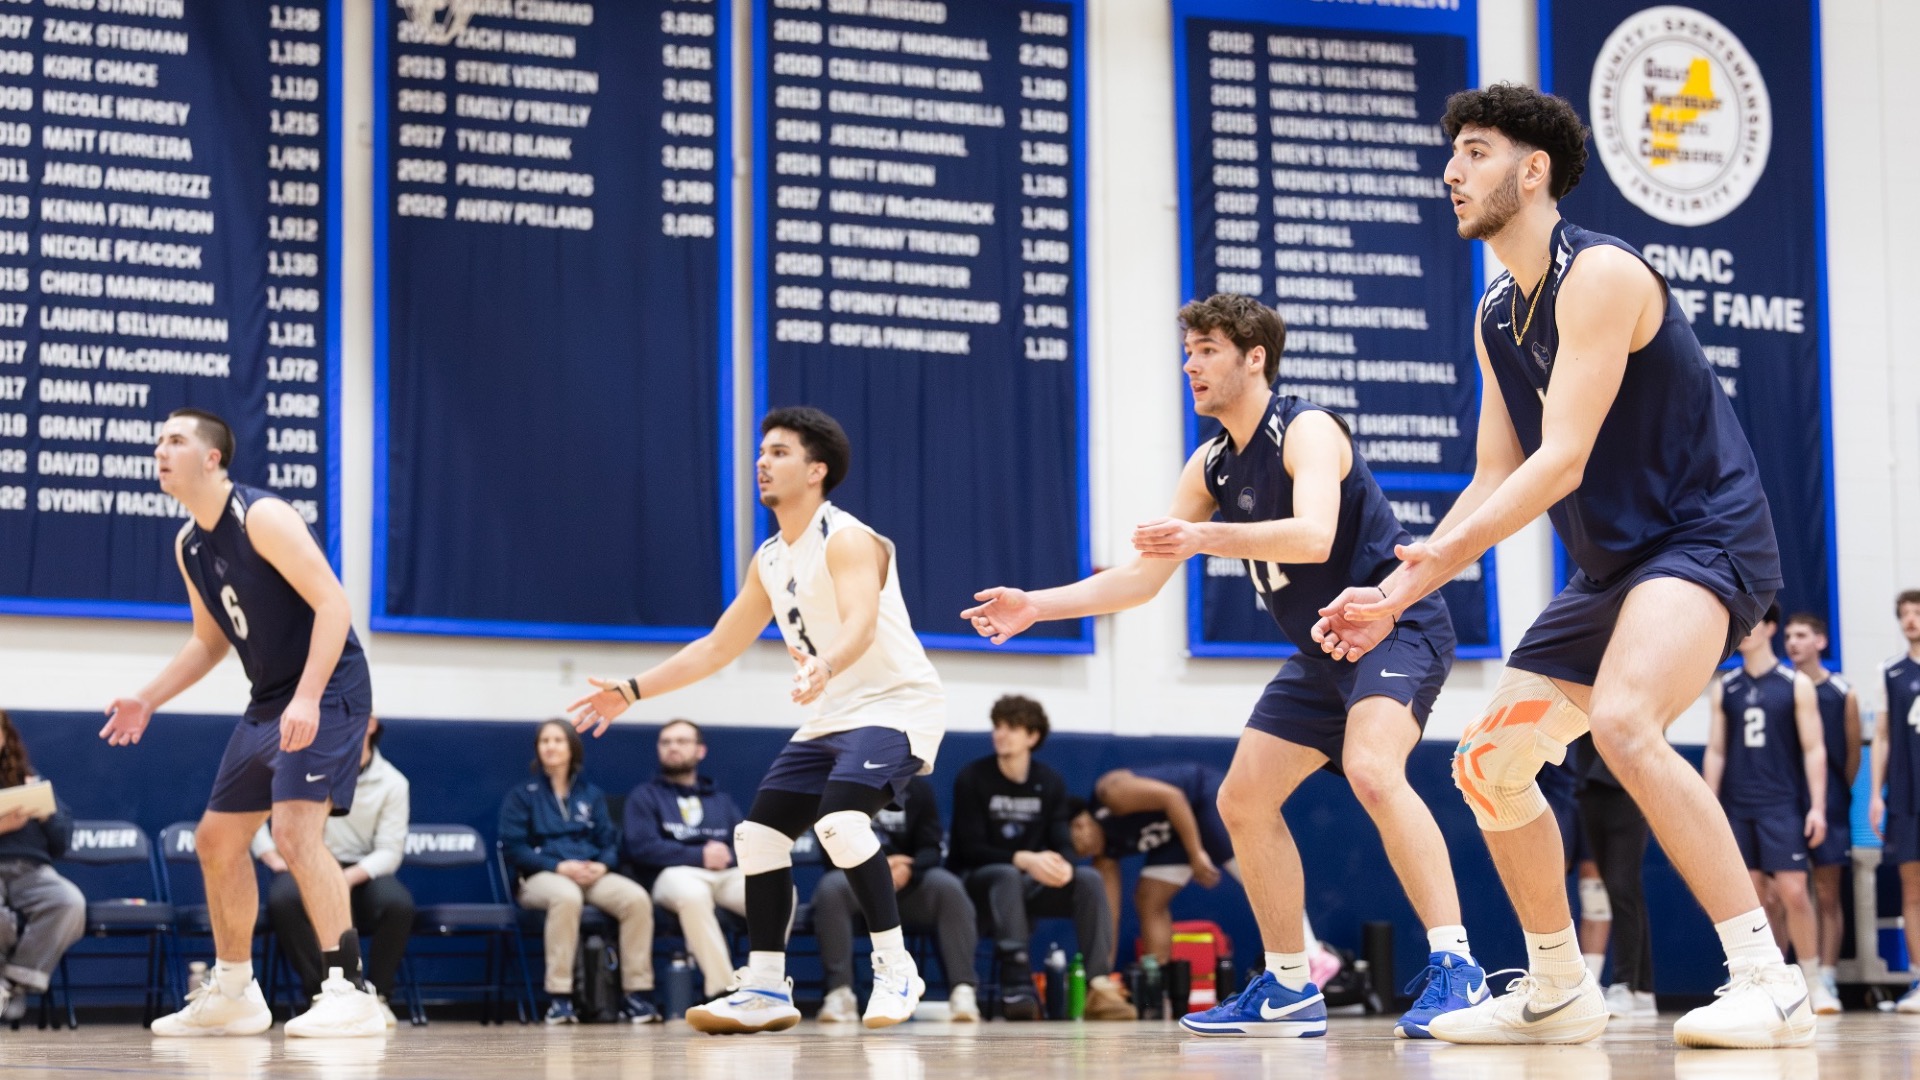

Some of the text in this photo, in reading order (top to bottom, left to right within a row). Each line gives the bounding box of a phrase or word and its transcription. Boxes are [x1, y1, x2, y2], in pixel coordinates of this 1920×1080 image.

[44, 19, 93, 45] ZACK
[96, 24, 188, 55] STEDMAN
[43, 55, 92, 81] KORI
[95, 60, 157, 87] CHACE
[456, 60, 511, 86] STEVE
[43, 90, 113, 118] NICOLE
[116, 97, 190, 125] HERSEY
[457, 95, 513, 120] EMILY
[514, 100, 590, 127] O'REILLY
[43, 126, 97, 152] MATT
[99, 131, 192, 161] FERREIRA
[457, 129, 511, 154] TYLER
[513, 134, 571, 159] BLANK
[42, 162, 102, 188] JARED
[104, 167, 210, 199] ANDREOZZI
[456, 164, 515, 189] PEDRO
[517, 169, 594, 196] CAMPOS
[41, 198, 106, 225] KENNA
[109, 203, 214, 234] FINLAYSON
[455, 199, 513, 223] AVERY
[515, 203, 593, 230] POLLARD
[830, 191, 885, 216] MOLLY
[41, 234, 111, 261] NICOLE
[114, 239, 201, 269] PEACOCK
[1643, 244, 1734, 284] GNAC
[40, 270, 103, 297] CHRIS
[106, 275, 214, 305] MARKUSON
[830, 290, 898, 316] SYDNEY
[40, 307, 114, 333] LAUREN
[117, 311, 228, 342] SILVERMAN
[1714, 292, 1804, 333] FAME
[40, 343, 103, 368] MOLLY
[106, 347, 230, 377] McCORMACK
[1357, 360, 1456, 383] BASKETBALL
[39, 379, 92, 404] DANA
[94, 382, 150, 407] MOTT
[39, 415, 103, 441] GRANT
[1358, 414, 1459, 437] BASKETBALL
[38, 451, 99, 477] DAVID
[269, 464, 317, 488] 1,170
[38, 488, 113, 513] SYDNEY
[221, 585, 248, 640] 6
[788, 607, 817, 657] 3
[1744, 708, 1766, 747] 2
